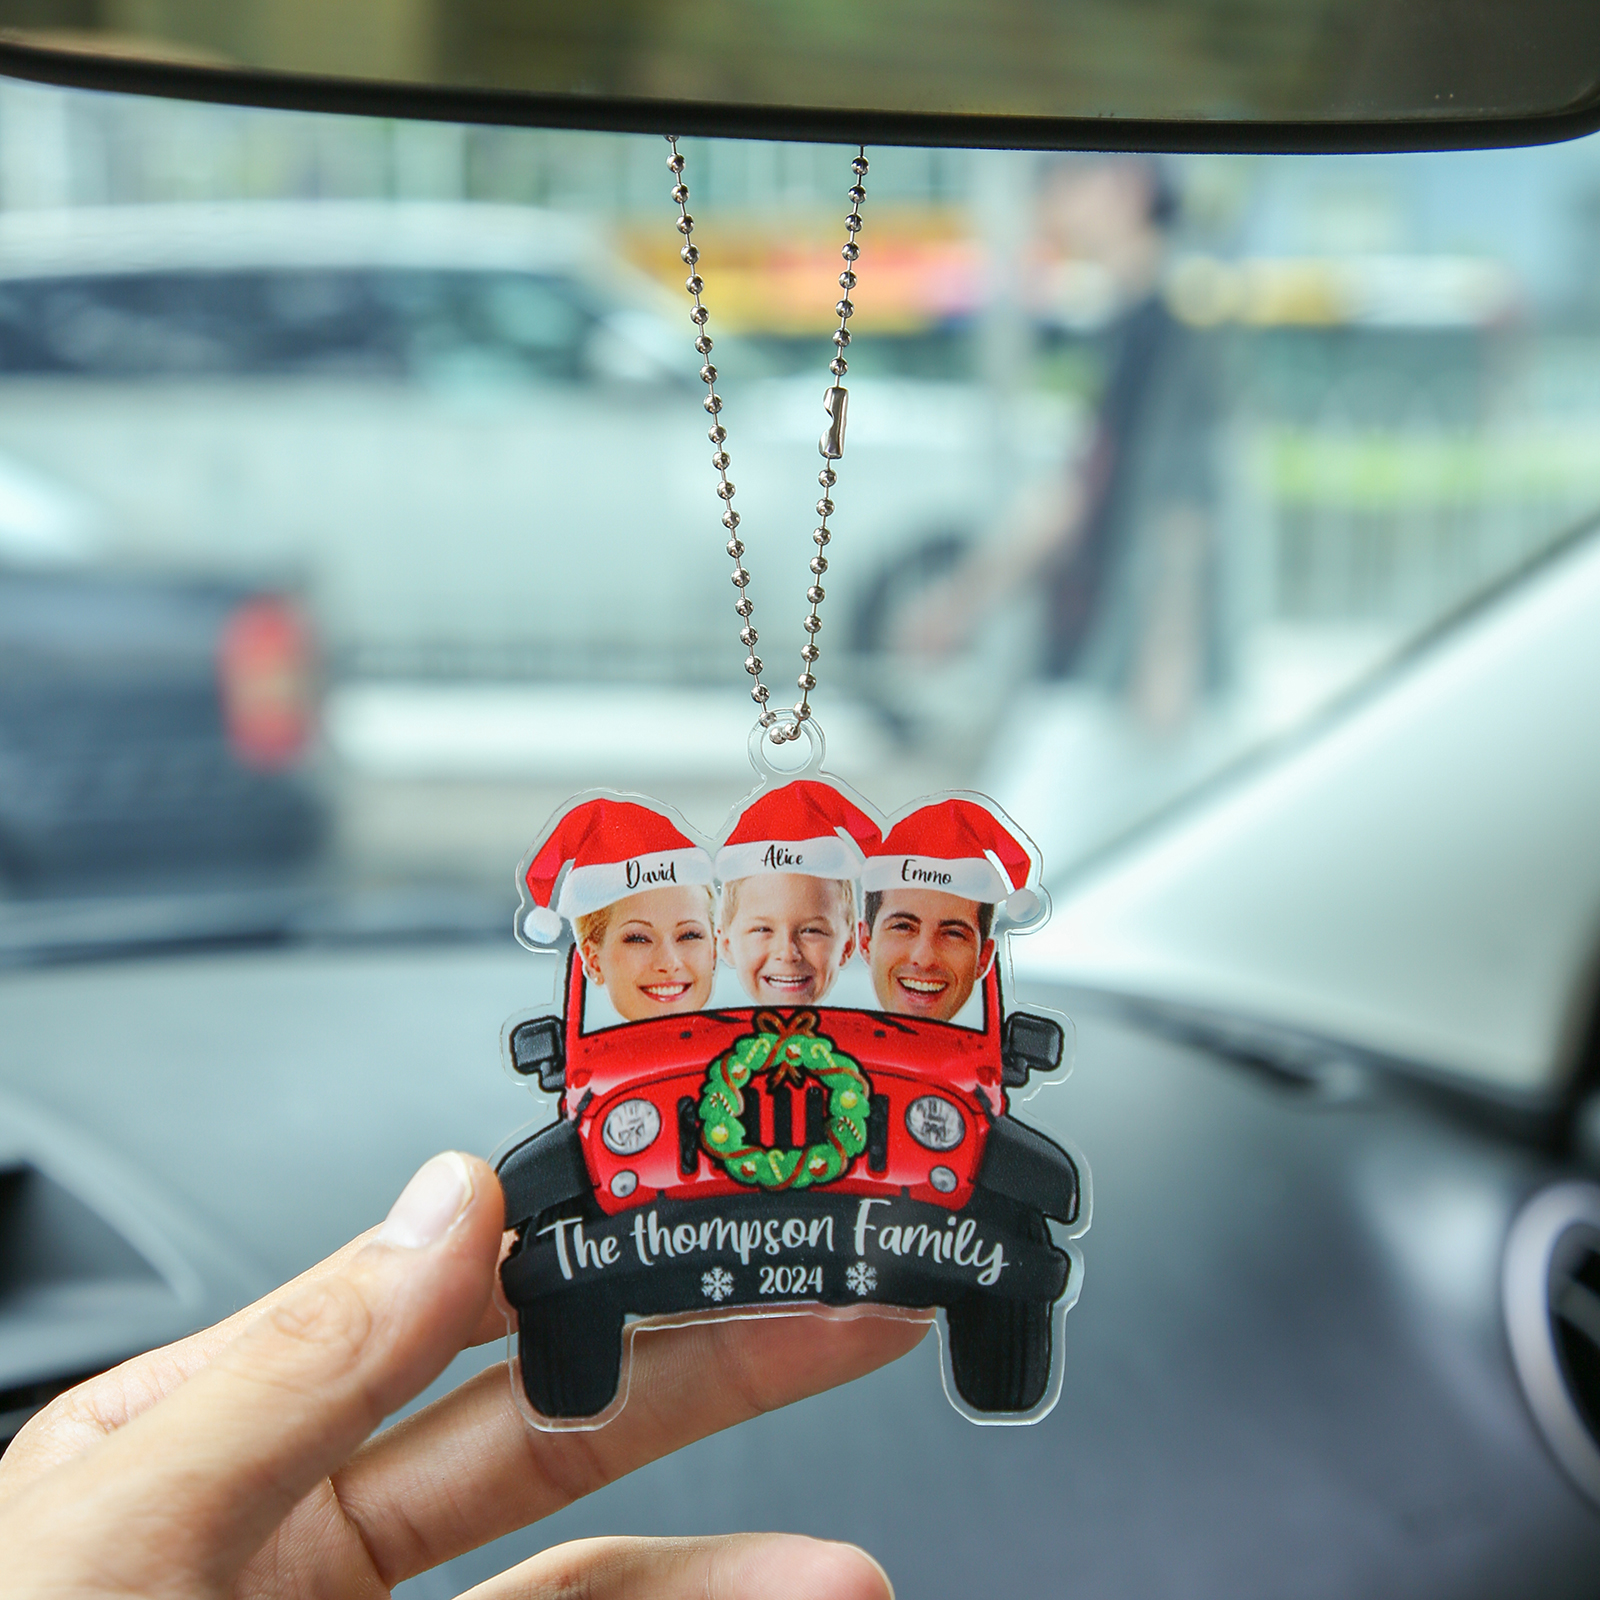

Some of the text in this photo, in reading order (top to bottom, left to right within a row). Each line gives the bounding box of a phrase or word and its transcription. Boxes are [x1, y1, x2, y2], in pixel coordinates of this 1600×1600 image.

[761, 844, 804, 868] Alice
[625, 861, 677, 888] David
[536, 1216, 621, 1280] The
[852, 1199, 1008, 1285] Family
[758, 1265, 824, 1295] 2024
